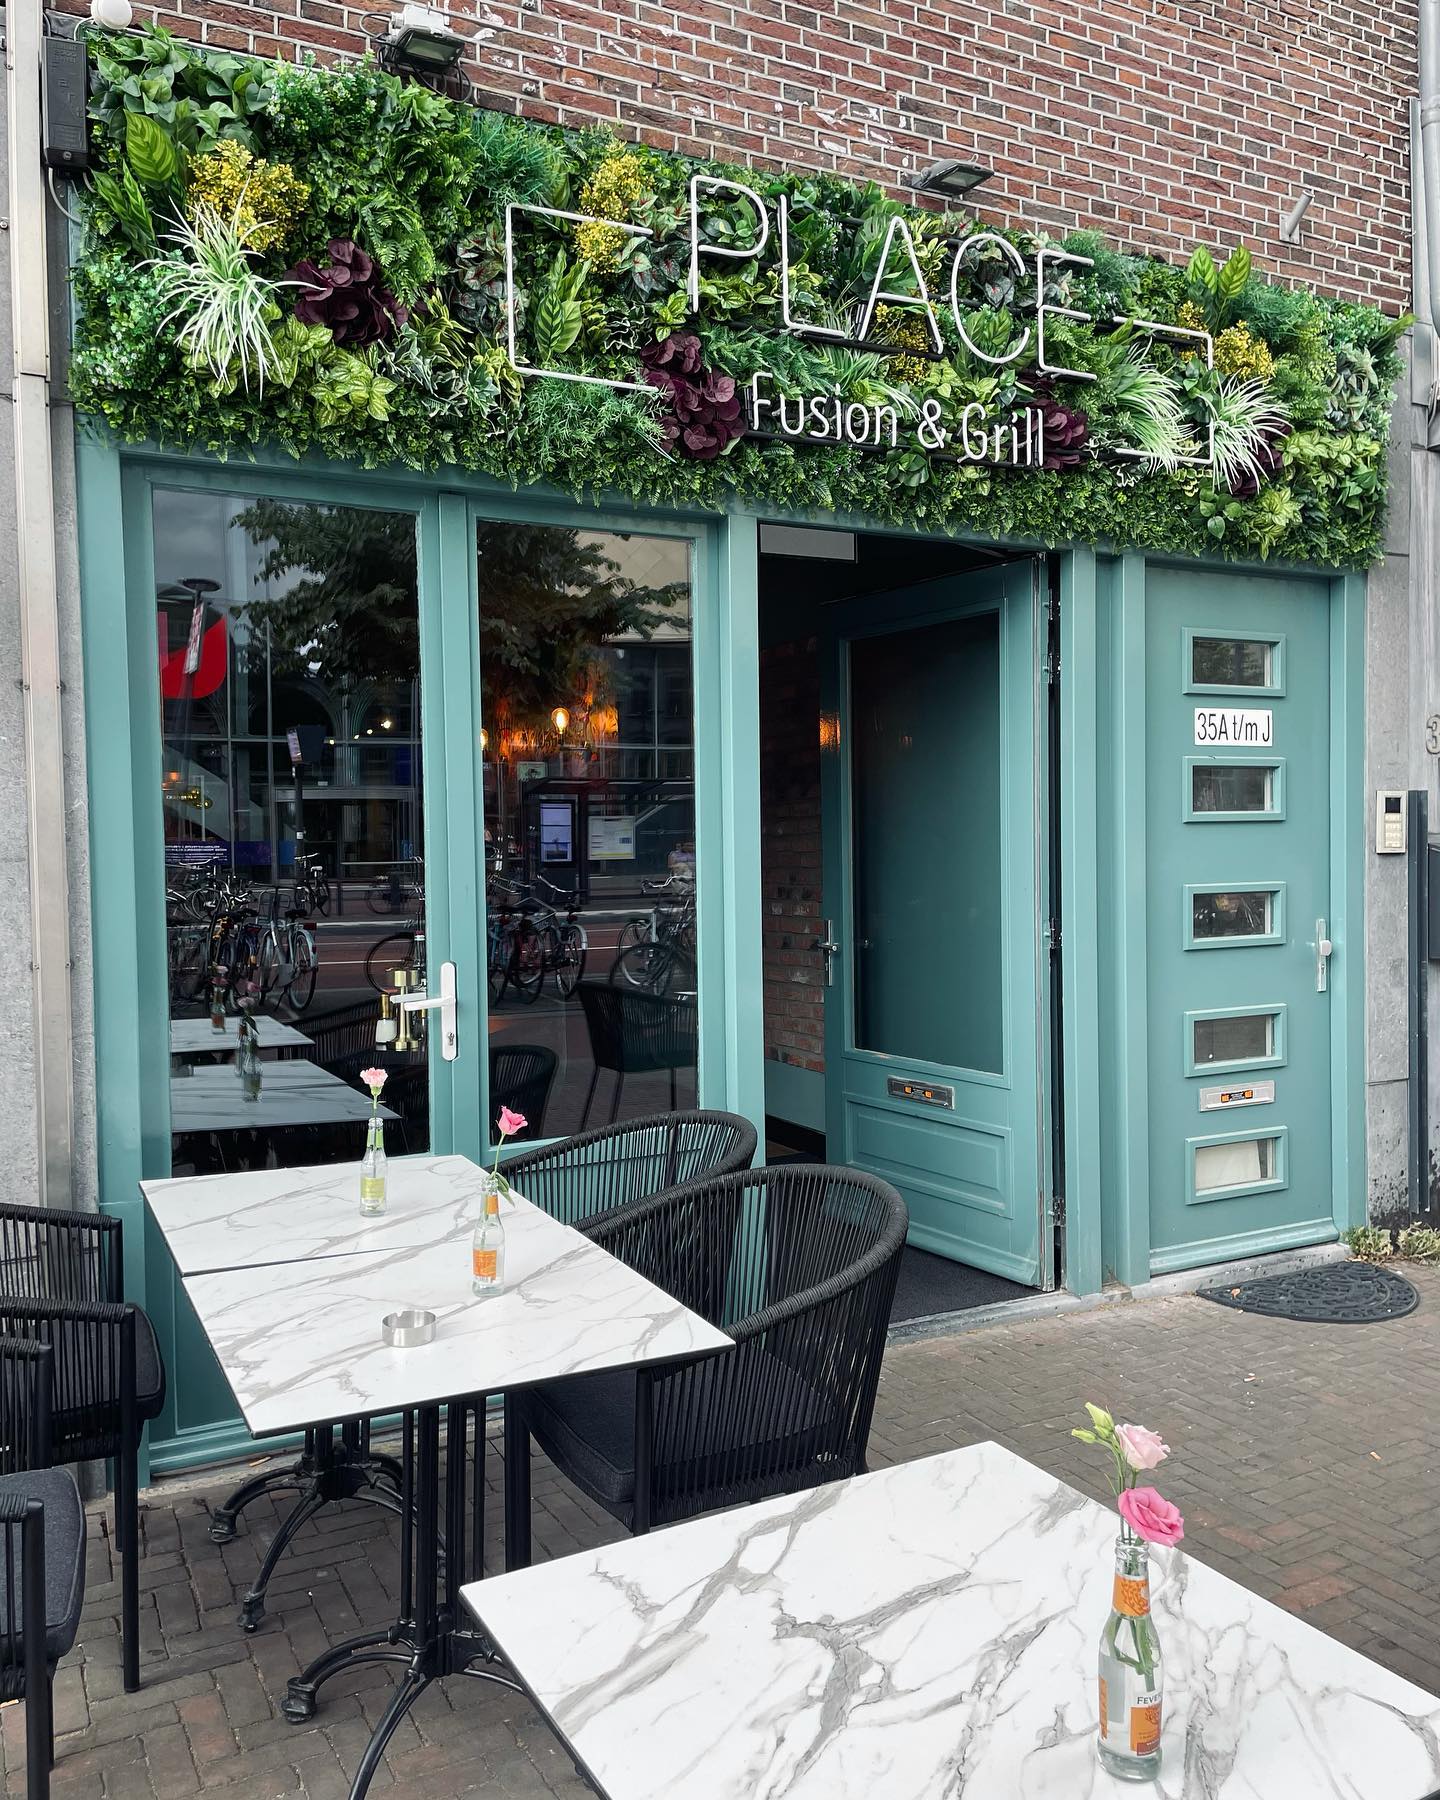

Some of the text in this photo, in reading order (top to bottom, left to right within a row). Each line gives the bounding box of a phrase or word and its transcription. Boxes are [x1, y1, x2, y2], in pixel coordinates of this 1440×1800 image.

[690, 174, 1098, 382] PLACE
[752, 371, 1045, 466] Fusion & Grill
[1197, 712, 1270, 742] 35A t/m J
